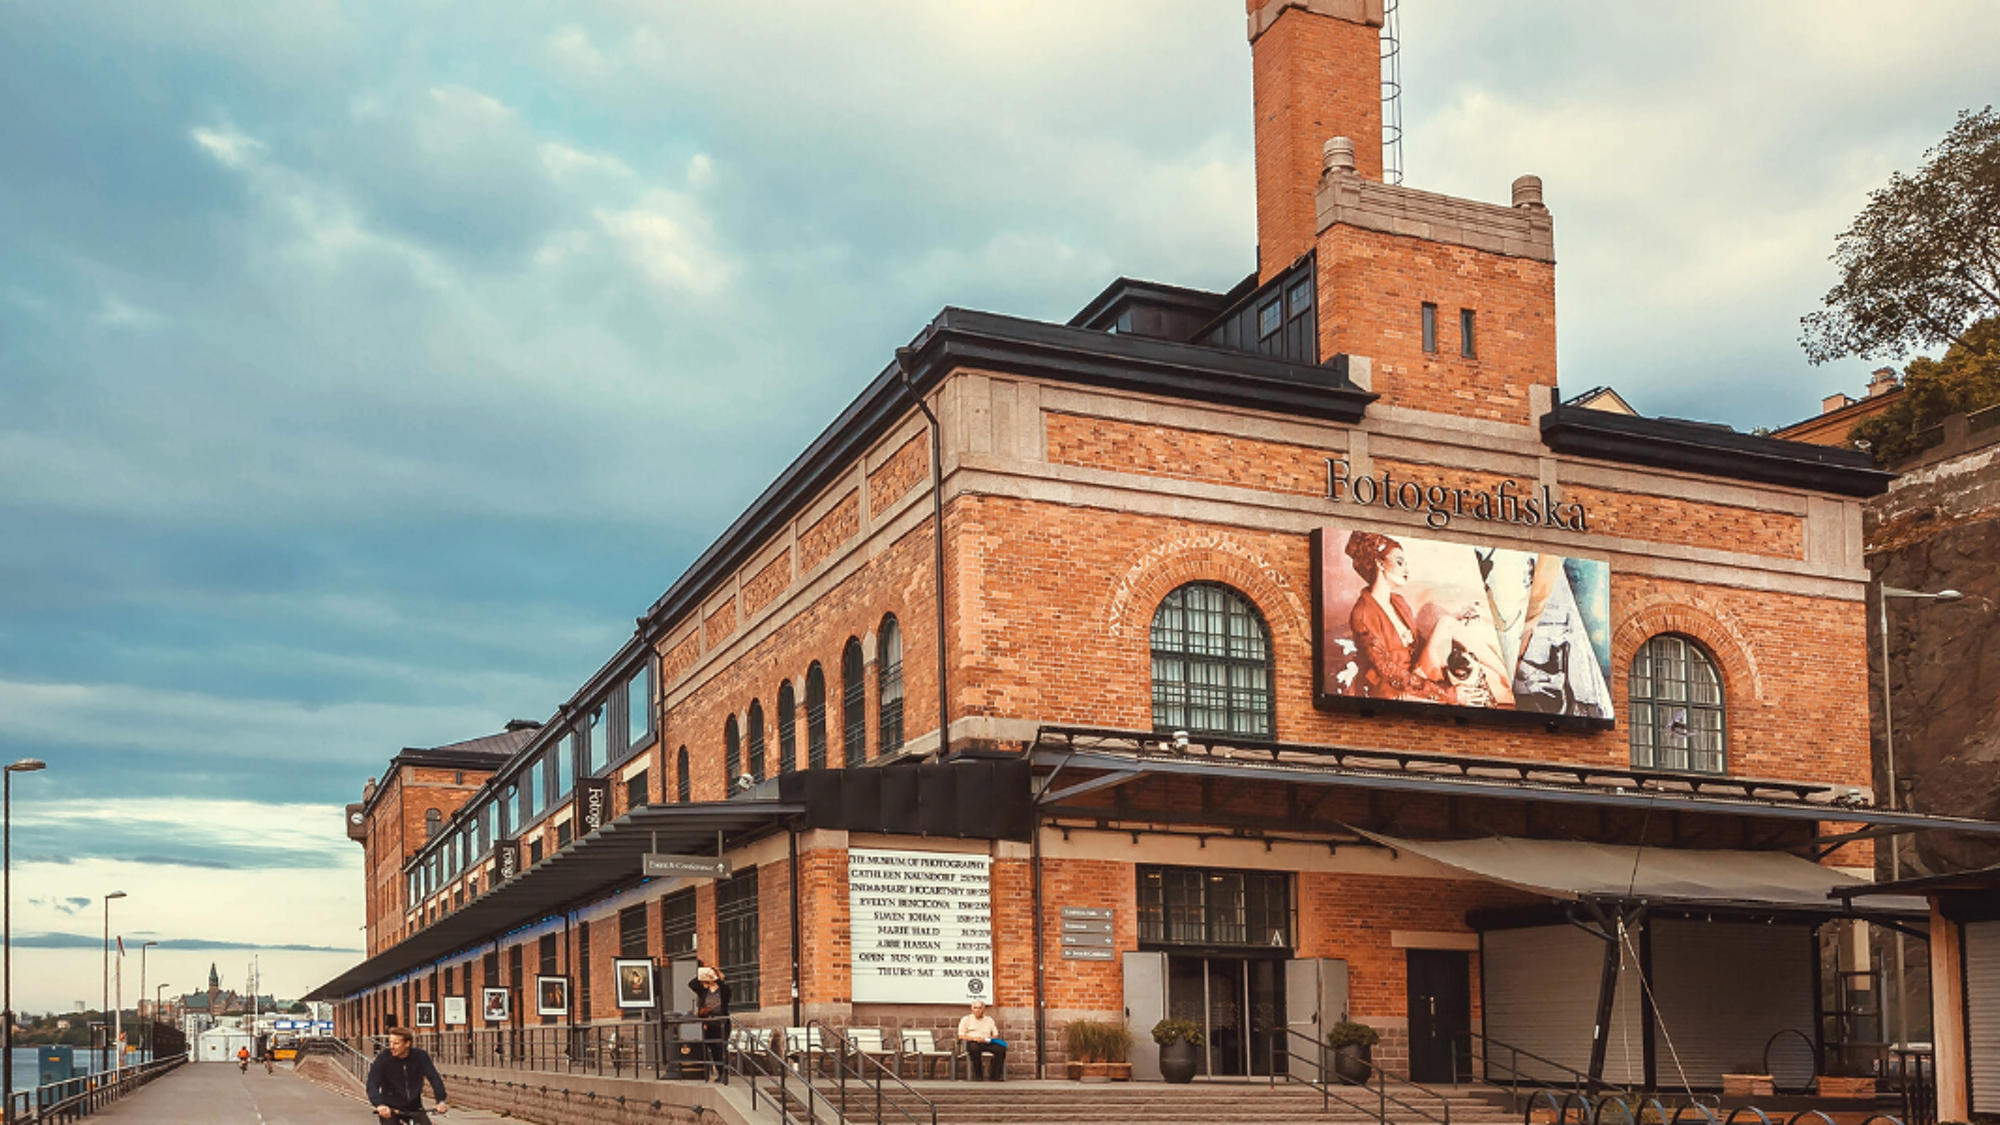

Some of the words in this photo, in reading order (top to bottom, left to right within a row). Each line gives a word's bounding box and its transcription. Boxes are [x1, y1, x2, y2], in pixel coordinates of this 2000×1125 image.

[1324, 457, 1588, 529] Fotografiska
[848, 854, 865, 864] THE
[868, 856, 905, 866] MUSEUM
[908, 857, 919, 867] OF
[920, 858, 985, 869] PHOTOGRAPHY
[851, 869, 902, 879] CATHLEEN
[860, 898, 896, 907] EVELYN
[873, 912, 905, 921] SIMEN
[908, 912, 941, 922] JOHAN
[877, 925, 909, 935] MARIE
[903, 940, 941, 950] HASSAN
[859, 952, 885, 961] OPEN
